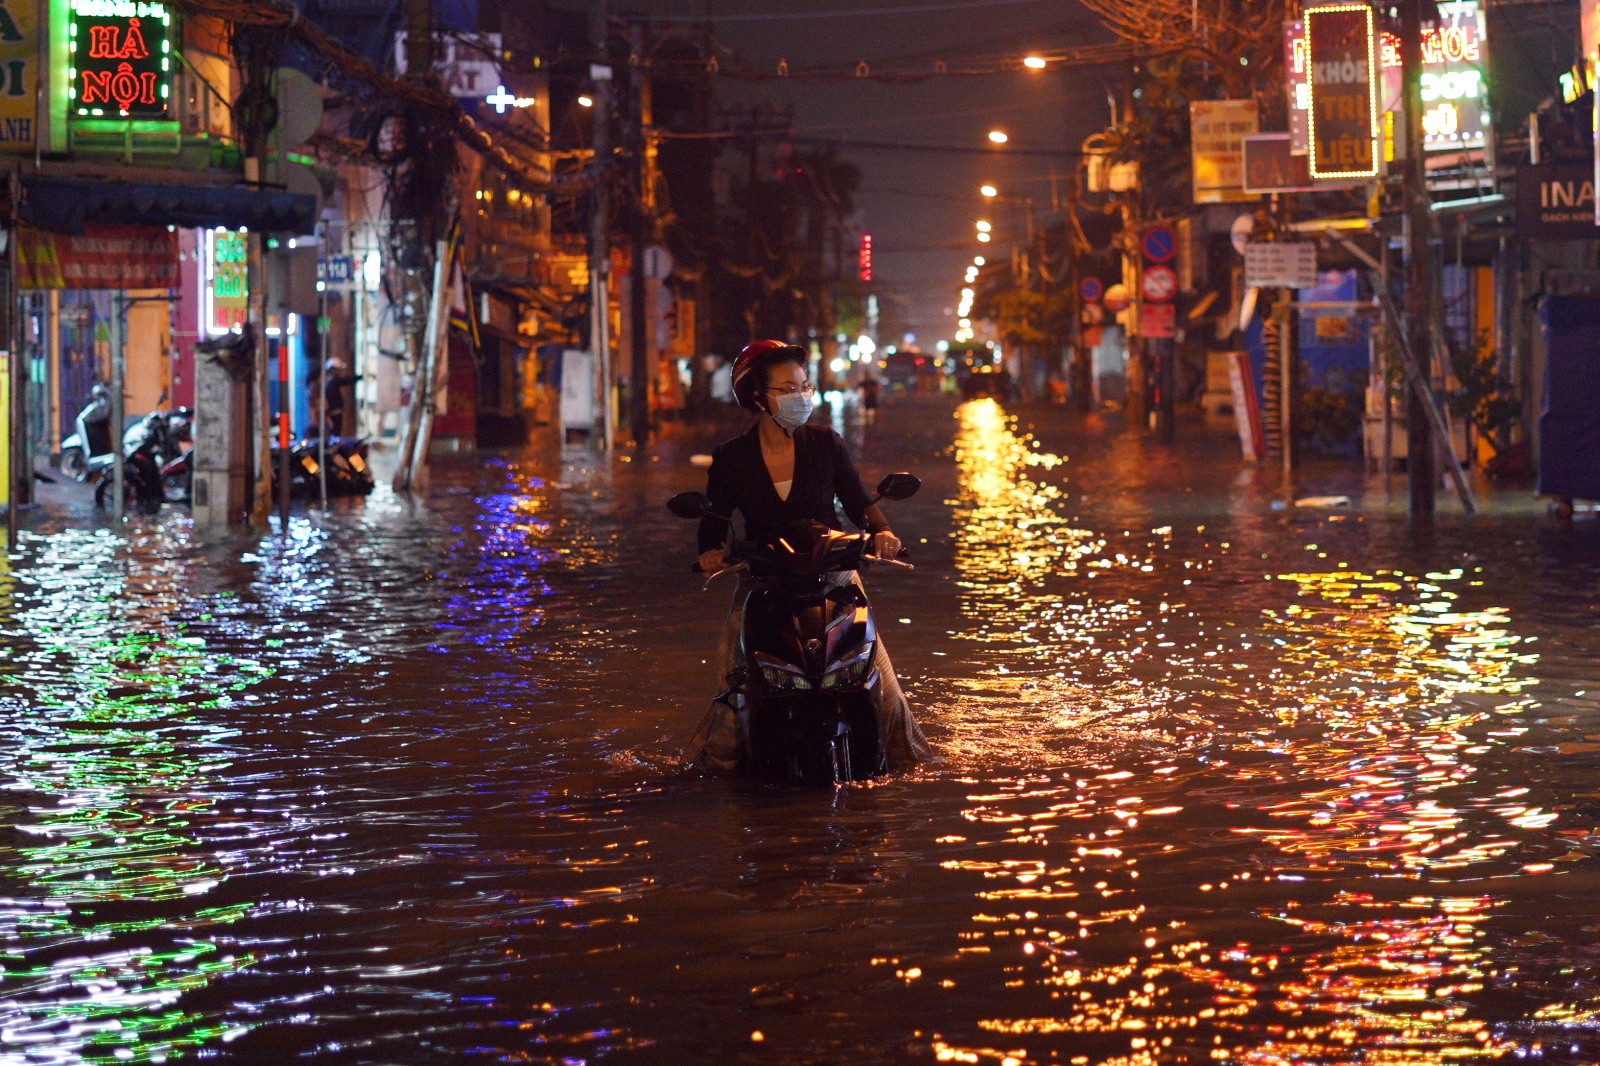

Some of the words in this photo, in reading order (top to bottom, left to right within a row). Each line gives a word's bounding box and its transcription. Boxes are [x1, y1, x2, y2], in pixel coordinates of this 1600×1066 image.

[88, 18, 149, 59] HÀ
[80, 61, 157, 111] NỘI
[1314, 52, 1368, 85] KHỎE
[1319, 95, 1365, 126] TRỊ
[1315, 133, 1371, 172] LIỆU
